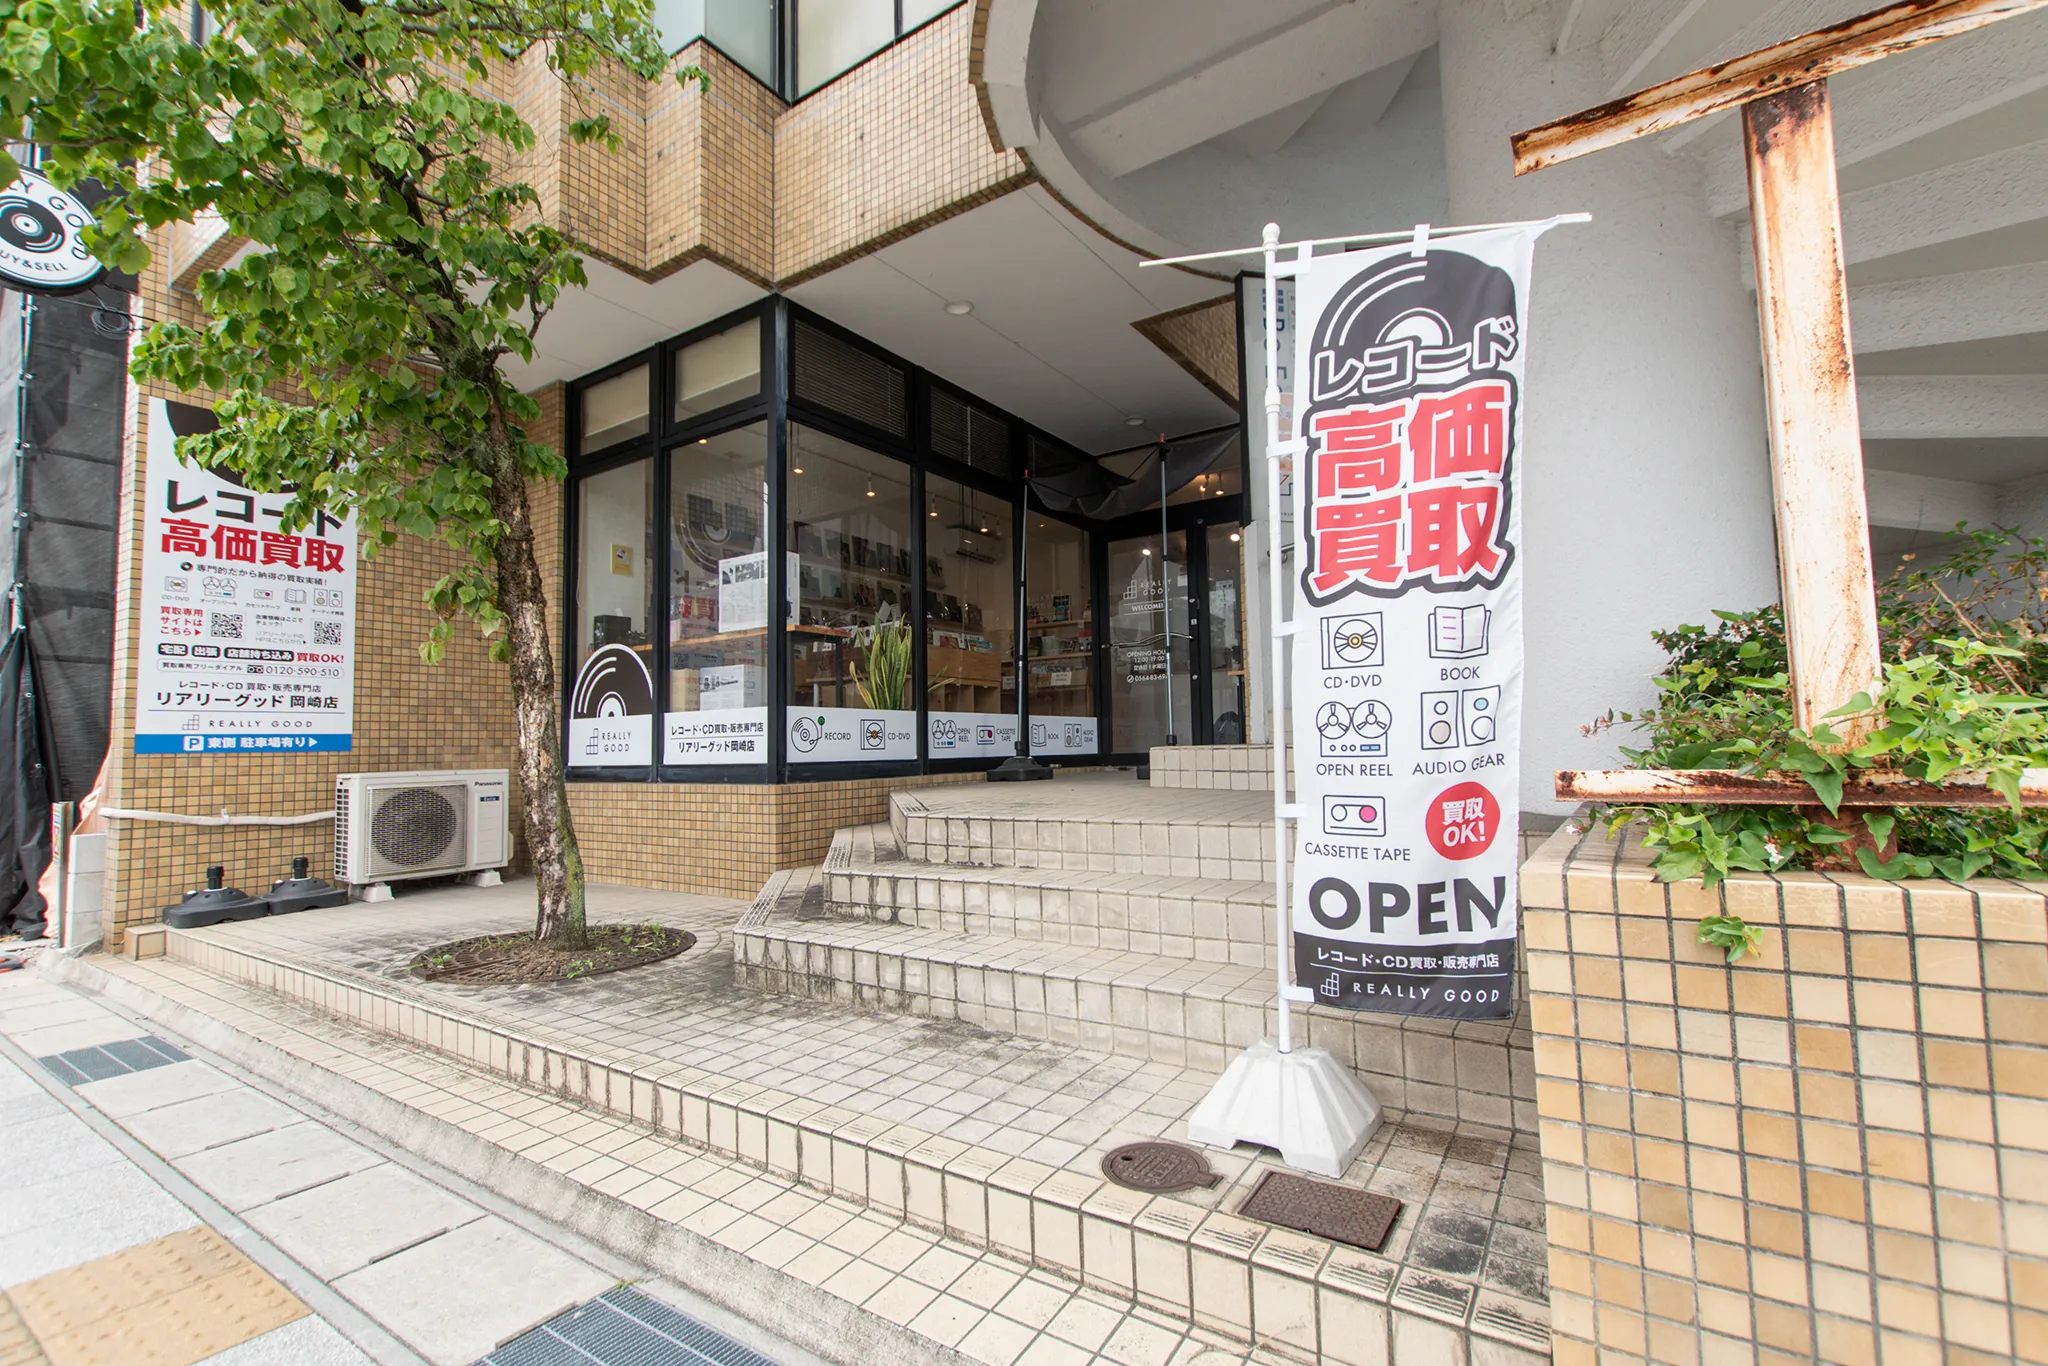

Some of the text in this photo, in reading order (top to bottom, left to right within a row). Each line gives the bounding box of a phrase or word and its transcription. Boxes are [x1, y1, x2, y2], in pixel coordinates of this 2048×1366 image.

[0, 249, 69, 271] UY&SELL
[1313, 315, 1518, 400] レコード
[1315, 386, 1505, 499] 高価
[1312, 485, 1501, 592] 買取
[160, 518, 345, 574] 高価買取
[160, 605, 204, 617] 買取専用
[1132, 602, 1164, 612] WELCOME!
[161, 616, 203, 627] サイトは
[160, 626, 192, 636] こちら
[1126, 649, 1152, 658] OPENING
[1440, 666, 1481, 681] BOOK
[208, 720, 313, 728] REALLY GOOD
[602, 732, 632, 741] REALLY
[824, 732, 852, 741] RECORD
[957, 728, 971, 736] OPEN
[996, 728, 1016, 736] CASSETTE
[1082, 729, 1094, 737] AUDIO
[958, 735, 970, 743] REEL
[1001, 735, 1012, 743] TAPE
[604, 743, 630, 753] GOOD
[678, 740, 755, 753] リアリーグッド岡崎店
[1316, 763, 1394, 777] OPEN REEL
[1412, 752, 1506, 776] AUDIO GEAR
[1442, 796, 1486, 827] 買取
[1443, 820, 1487, 848] OK!
[1304, 842, 1411, 862] CASSETTE TAPE
[1308, 875, 1507, 936] OPEN
[1352, 981, 1500, 1003] REALLY GOOD
